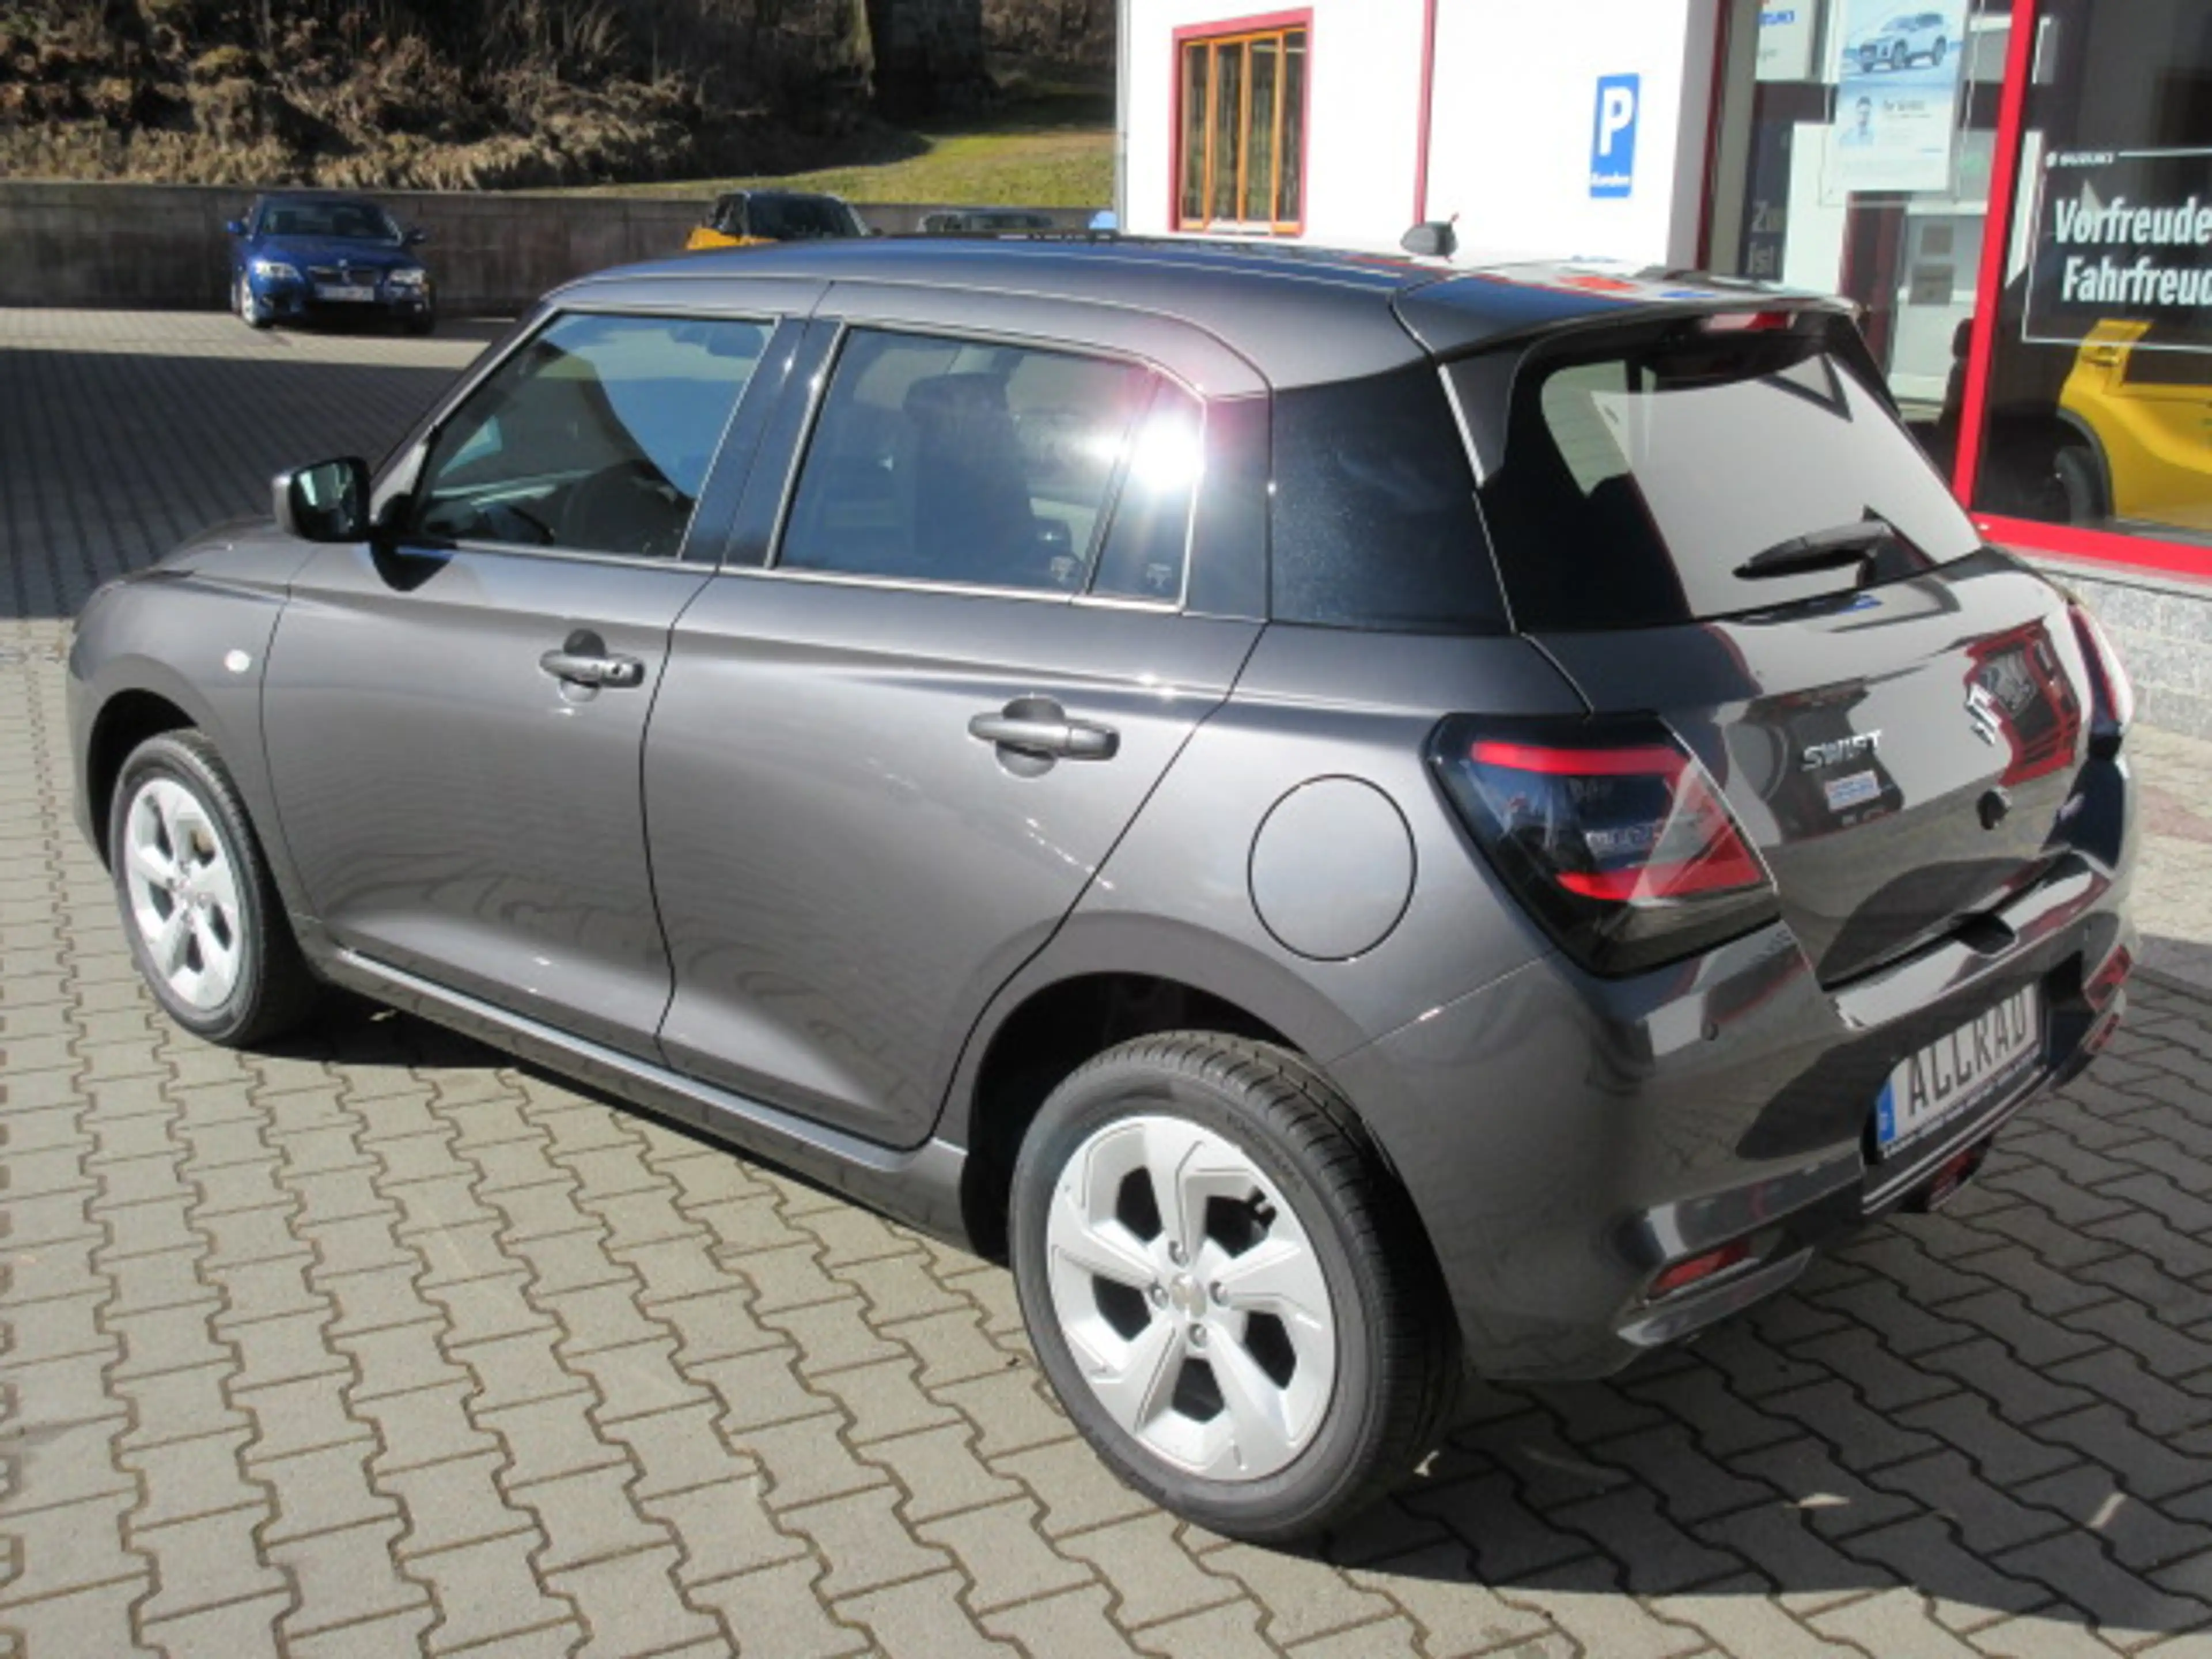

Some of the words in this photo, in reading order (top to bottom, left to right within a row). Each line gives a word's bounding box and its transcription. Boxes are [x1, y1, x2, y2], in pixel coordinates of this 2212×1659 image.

[1600, 88, 1633, 156] P
[2054, 195, 2212, 245] Vorfreude
[1801, 728, 1883, 772] SWIFT
[1907, 992, 2027, 1118] ALLRAD
